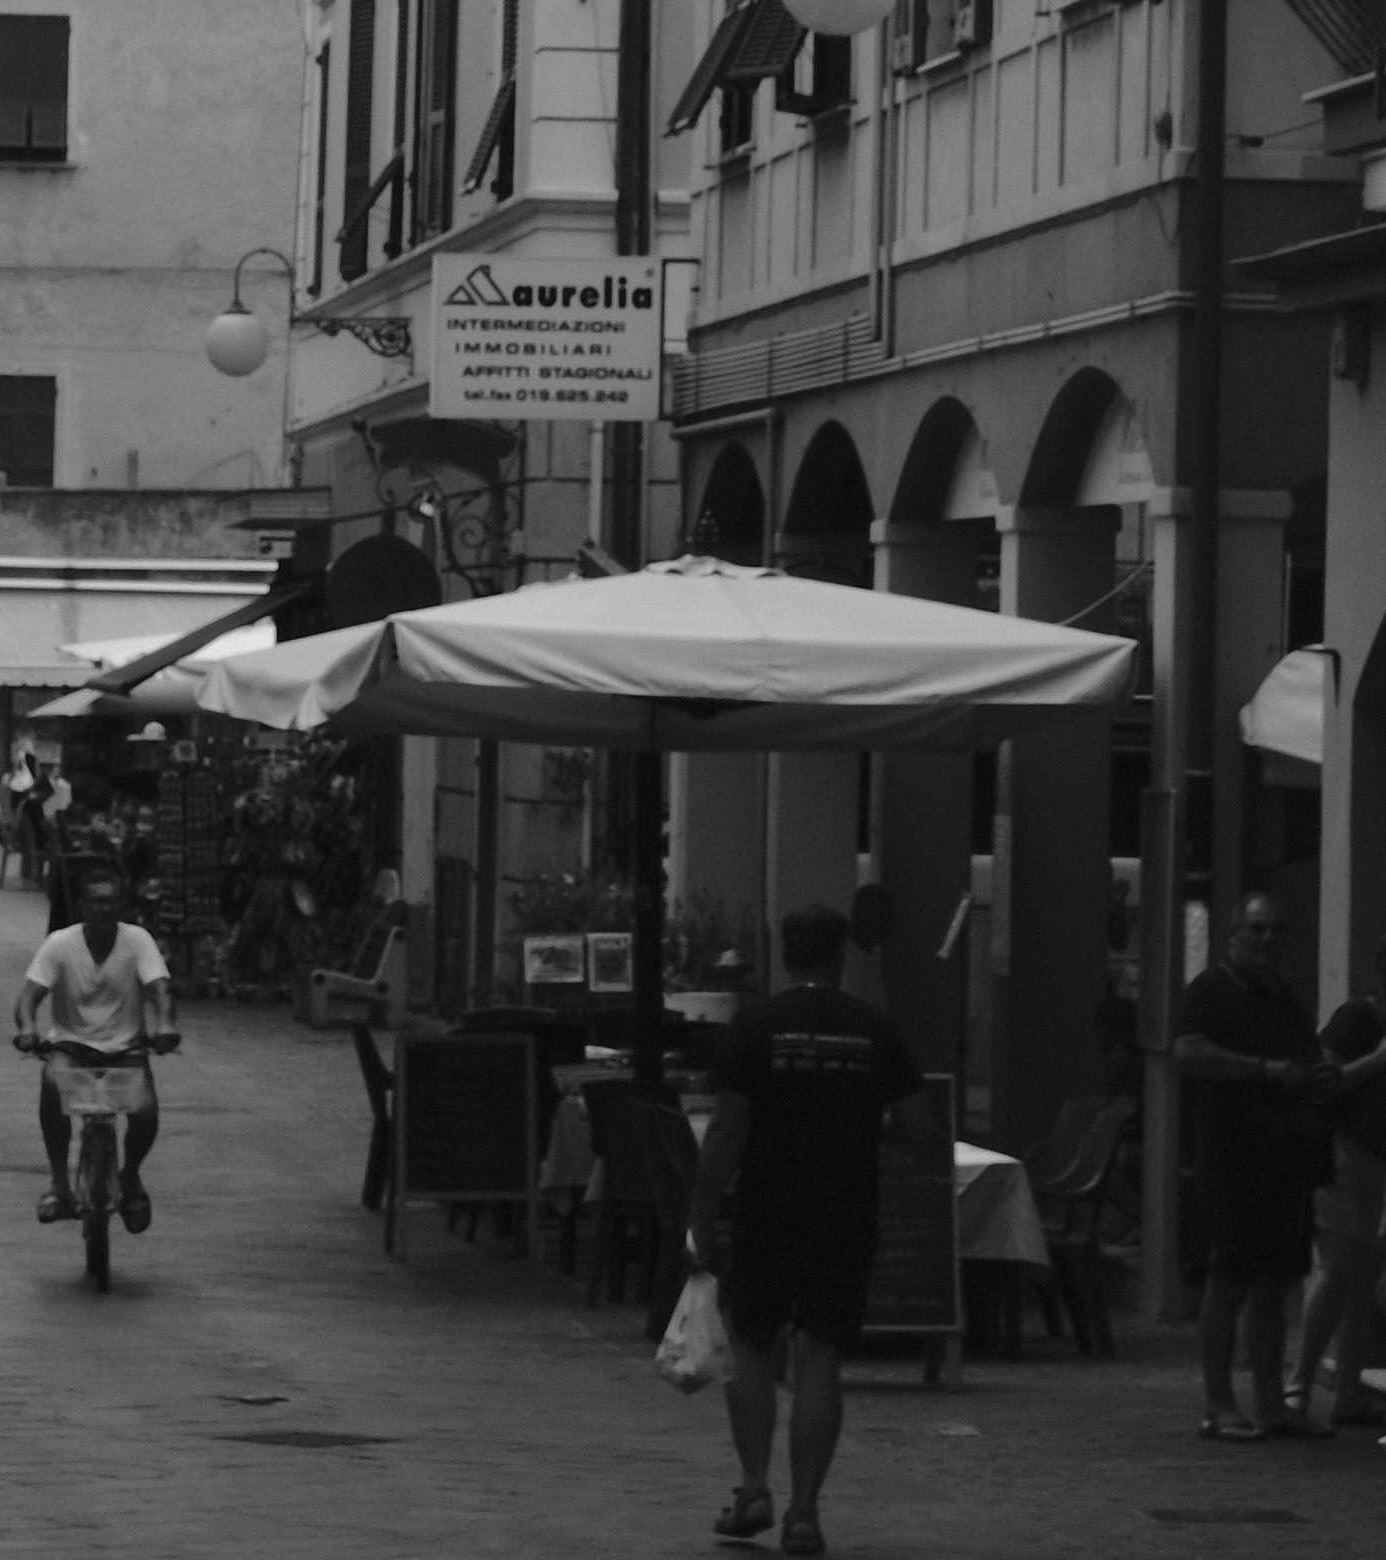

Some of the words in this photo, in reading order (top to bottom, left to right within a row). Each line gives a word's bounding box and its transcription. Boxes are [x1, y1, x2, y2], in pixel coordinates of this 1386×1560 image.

[512, 275, 653, 309] aurelia
[446, 318, 626, 334] INTERMEDIAZIONI
[454, 341, 612, 356] IMMOBILIARI
[461, 365, 531, 378] AFFITTI
[538, 366, 653, 380] STAGIONALI
